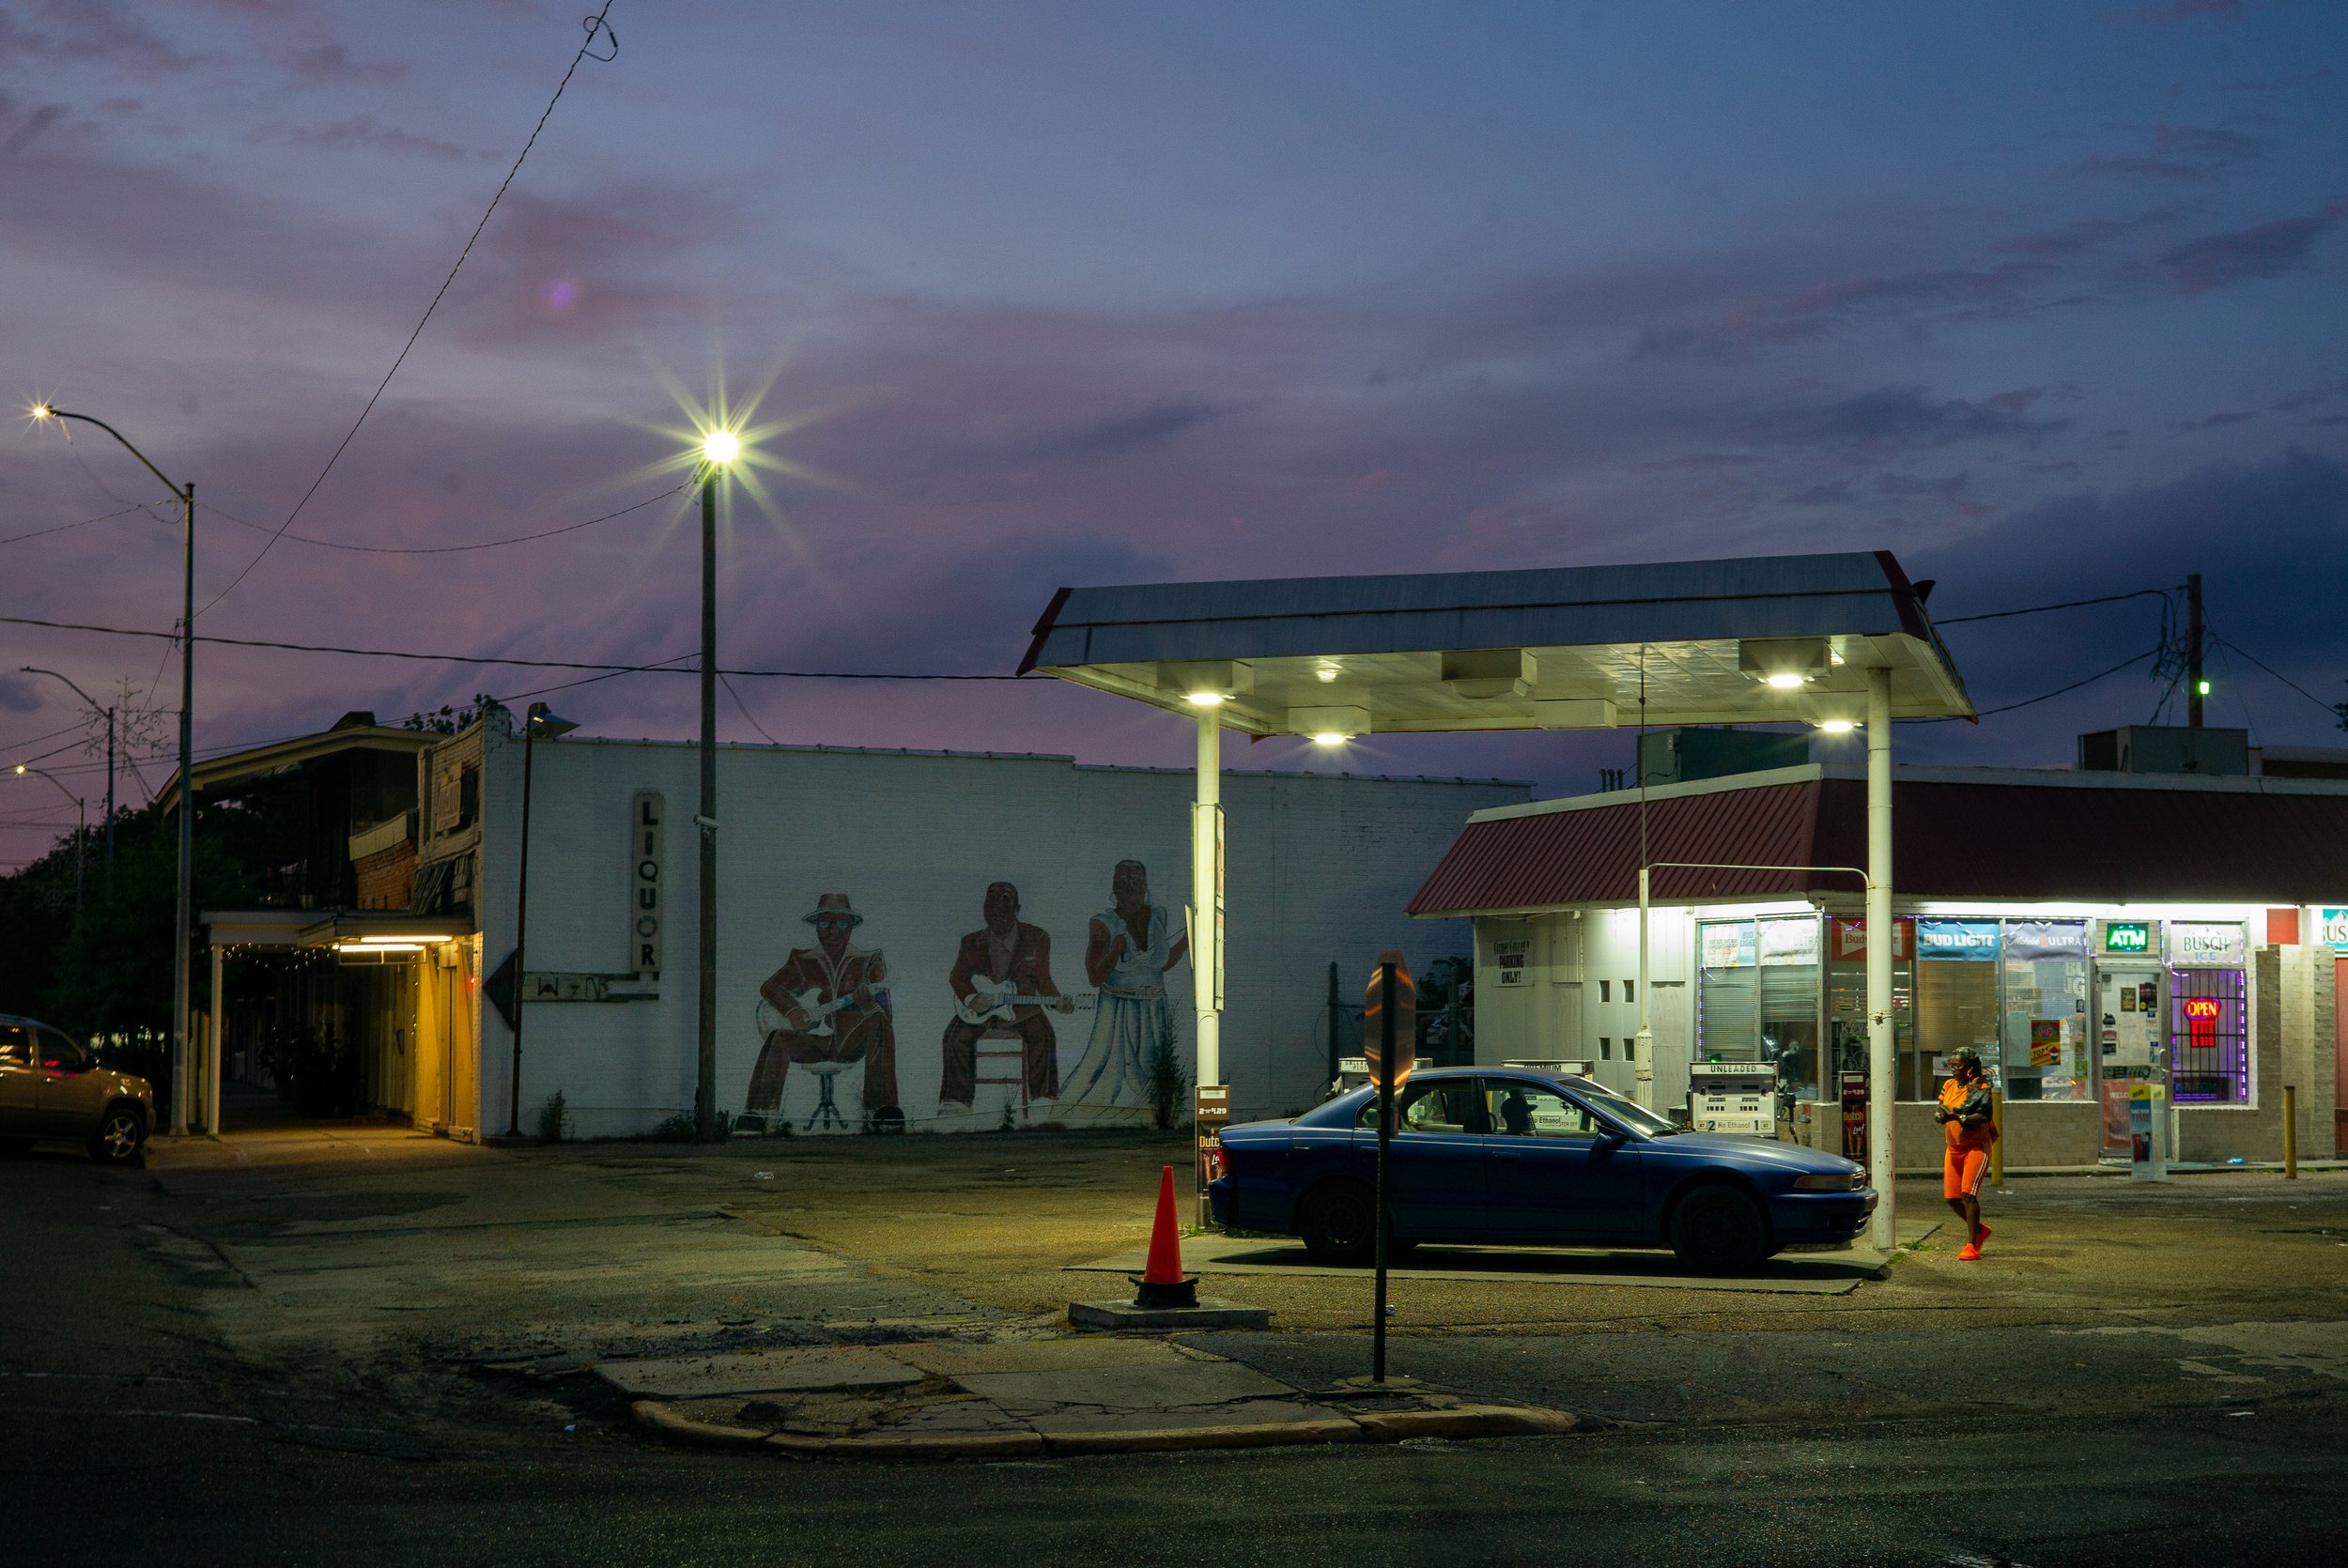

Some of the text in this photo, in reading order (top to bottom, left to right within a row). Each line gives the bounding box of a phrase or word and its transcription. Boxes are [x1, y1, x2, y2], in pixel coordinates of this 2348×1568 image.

[637, 801, 658, 966] LIQUOR
[1923, 932, 1994, 946] BUD LIGHT
[2047, 936, 2082, 945] ULTRA
[2109, 930, 2146, 945] ATM
[2184, 936, 2229, 951] BUSCH
[1499, 954, 1524, 969] PARKING
[2194, 952, 2217, 961] ICE
[2187, 1001, 2217, 1016] OPEN
[1843, 1112, 1864, 1121] Dutch
[1707, 1120, 1716, 1131] 2
[1753, 1120, 1759, 1131] 1
[1198, 1135, 1220, 1147] Dutc
